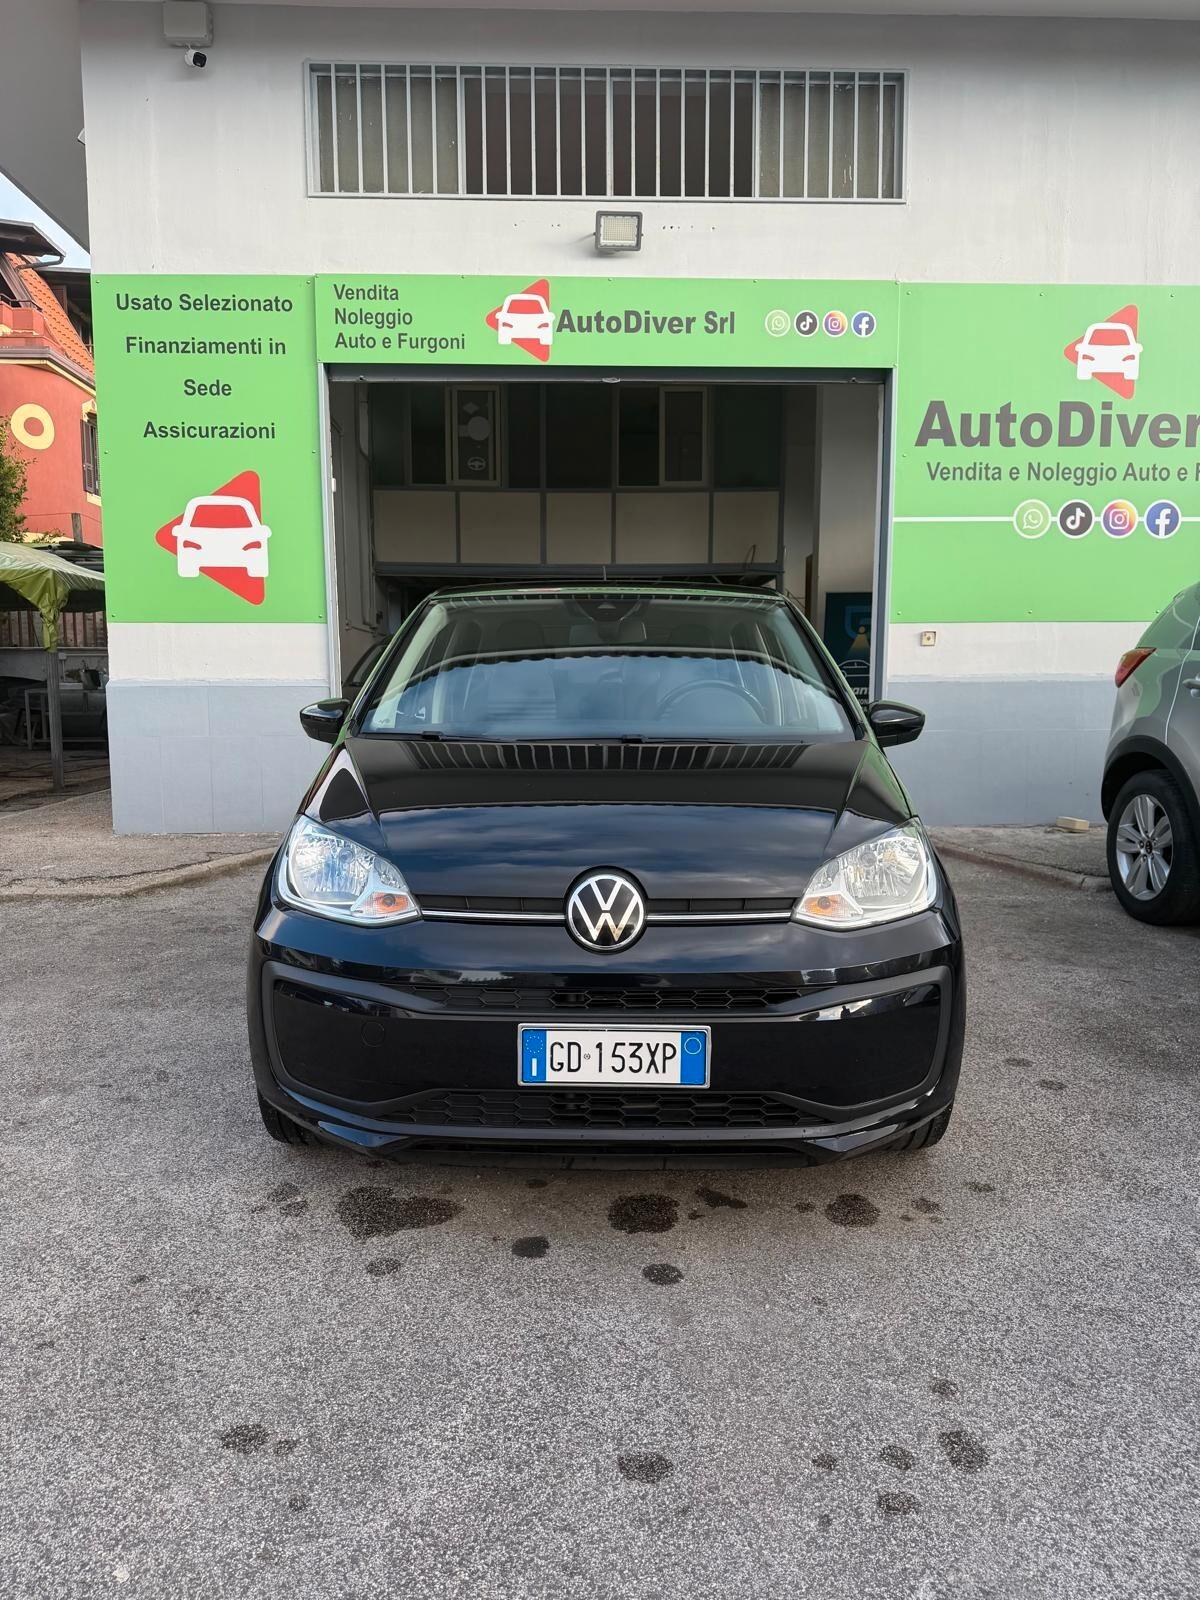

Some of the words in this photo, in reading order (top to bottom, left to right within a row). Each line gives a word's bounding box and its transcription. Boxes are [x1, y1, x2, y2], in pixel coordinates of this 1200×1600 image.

[333, 284, 400, 301] Vendita
[116, 293, 173, 311] Usato
[178, 293, 294, 313] Selezionato
[334, 307, 414, 328] Noleggio
[556, 309, 696, 335] AutoDiver
[703, 310, 736, 335] Srl
[125, 336, 262, 355] Finanziamenti
[268, 338, 287, 355] in
[335, 332, 377, 349] Auto
[382, 336, 392, 349] e
[397, 332, 466, 354] Furgoni
[183, 378, 232, 397] Sede
[143, 421, 276, 439] Assicurazioni
[926, 461, 1002, 482] Vendita
[1008, 466, 1021, 482] e
[1027, 461, 1118, 487] Noleggio
[1122, 462, 1171, 482] Auto
[1177, 466, 1188, 482] e
